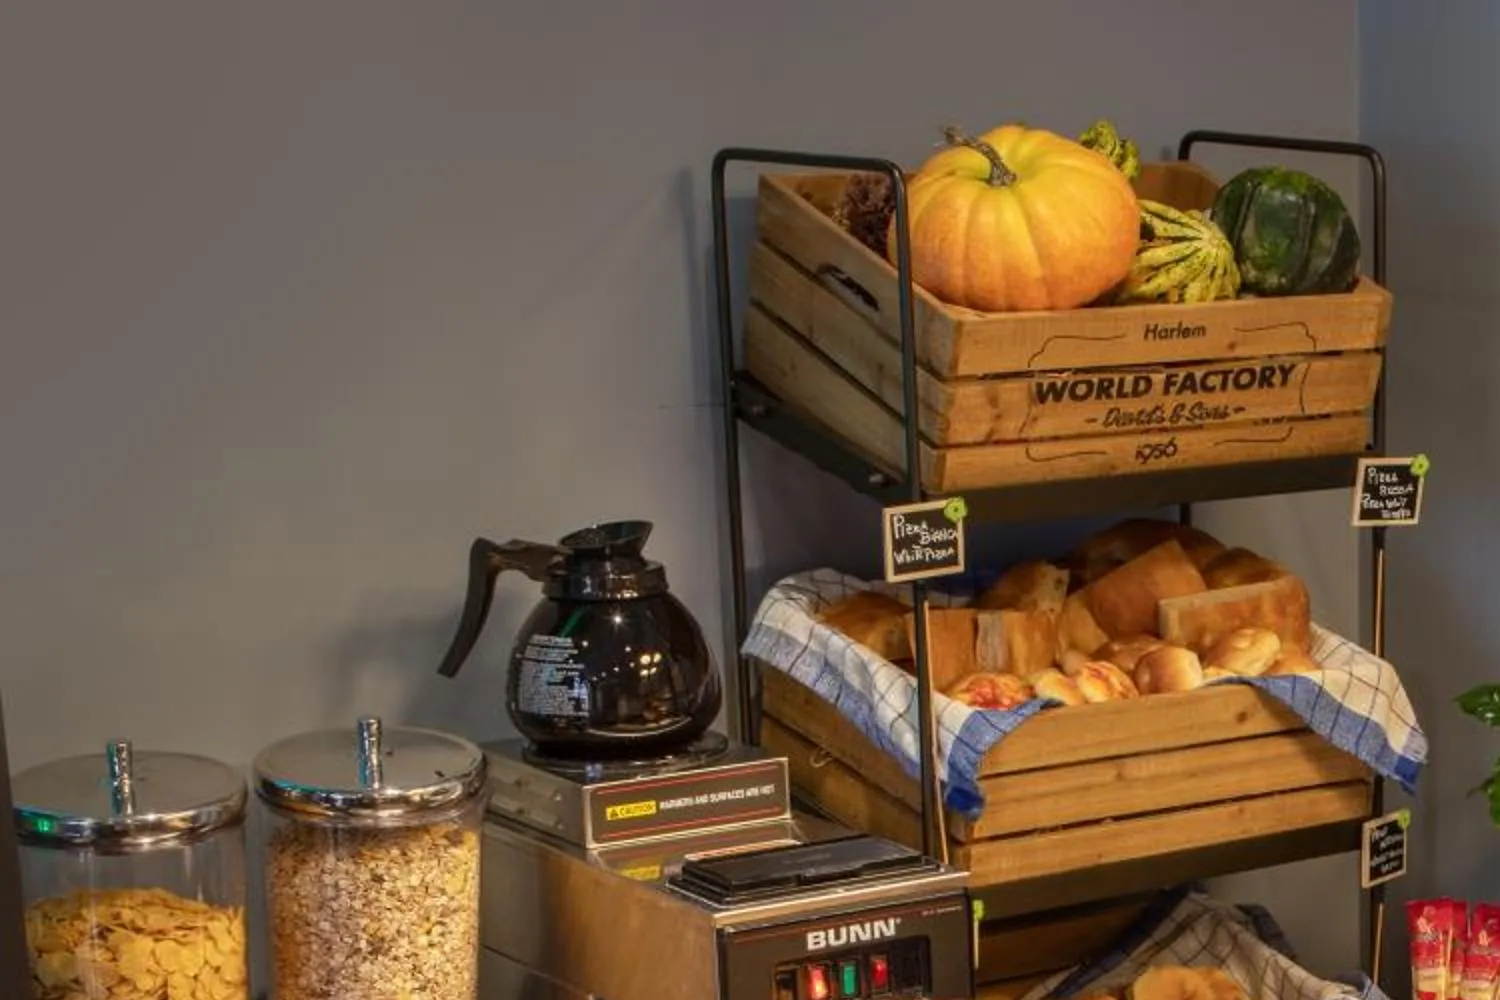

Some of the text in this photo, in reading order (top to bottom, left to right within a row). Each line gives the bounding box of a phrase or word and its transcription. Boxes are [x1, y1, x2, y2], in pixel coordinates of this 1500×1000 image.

[1143, 321, 1207, 341] Harlem
[1034, 363, 1296, 404] WORLD FACTORY
[1135, 437, 1178, 464] 1956
[806, 918, 897, 951] BUNN
